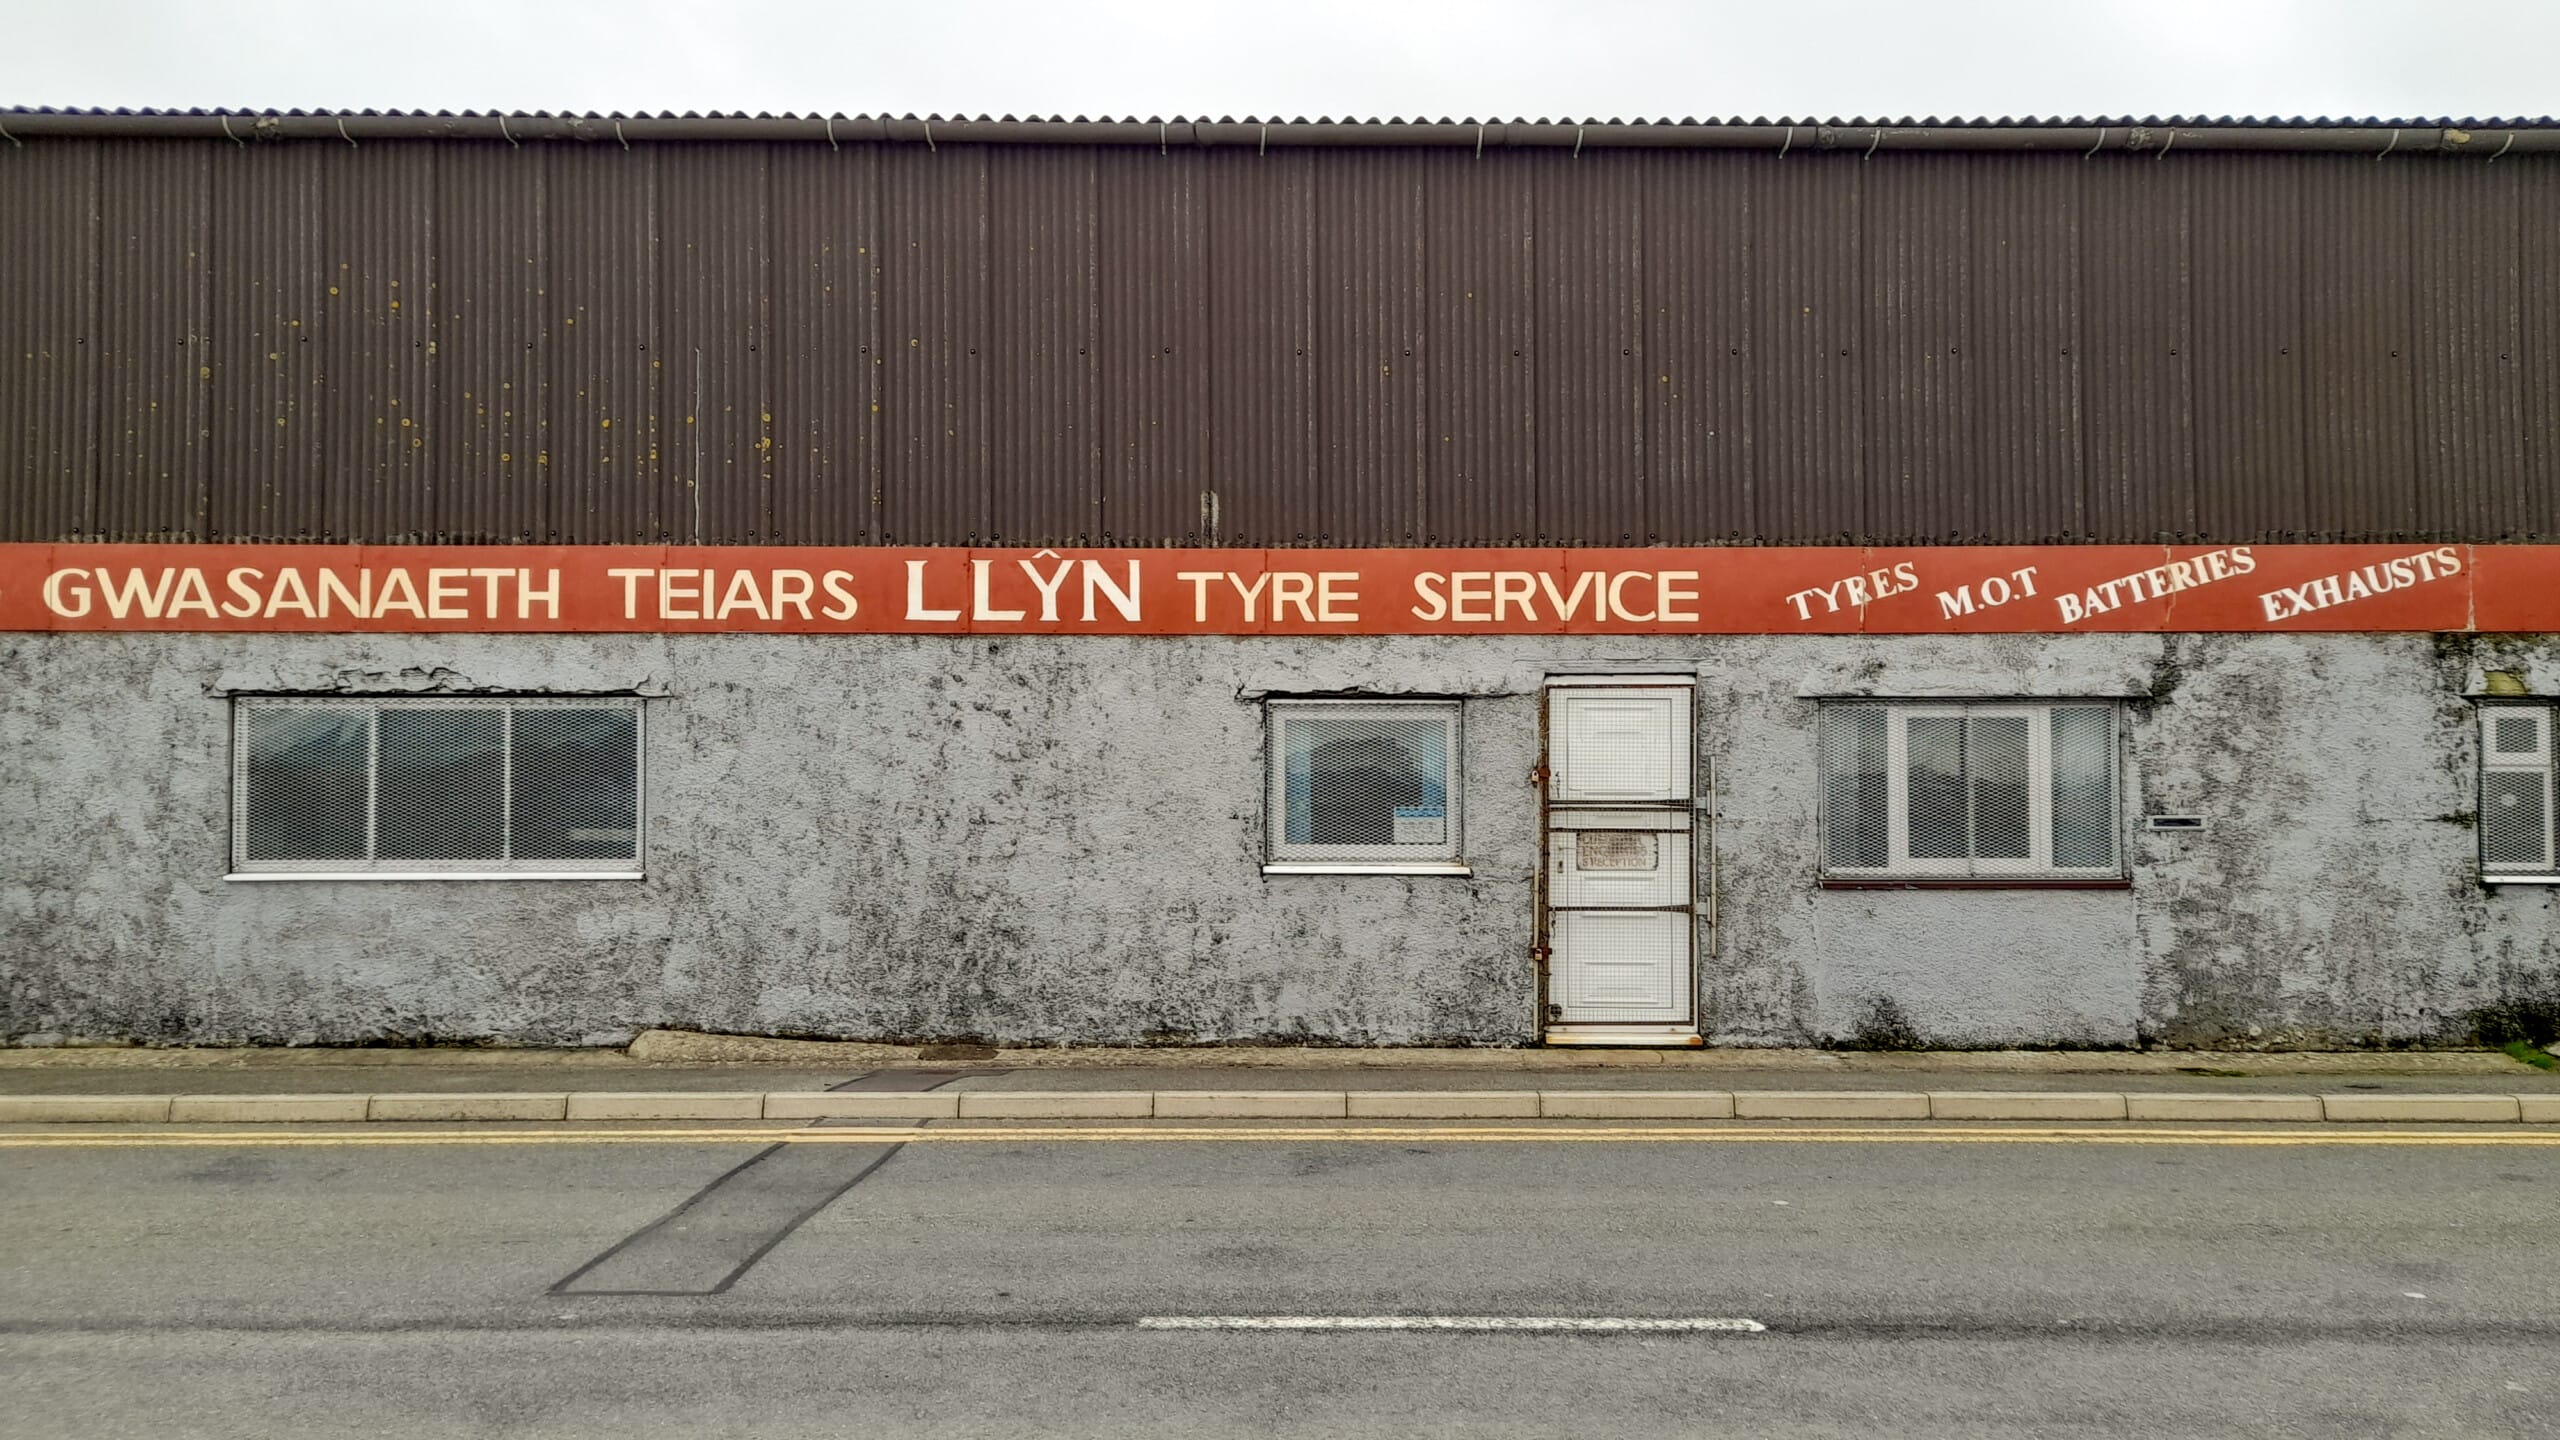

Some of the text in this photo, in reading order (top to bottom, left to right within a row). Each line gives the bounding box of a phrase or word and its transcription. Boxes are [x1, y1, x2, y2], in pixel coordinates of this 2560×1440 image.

[42, 549, 1700, 623] GWASANAETH TEIARS LLŶN TYRE SERVICE
[1786, 562, 1919, 622] TYRES
[1936, 566, 2040, 621] M.O.T
[2055, 546, 2256, 624] BATTERIES
[2259, 546, 2462, 624] EXHAUSTS
